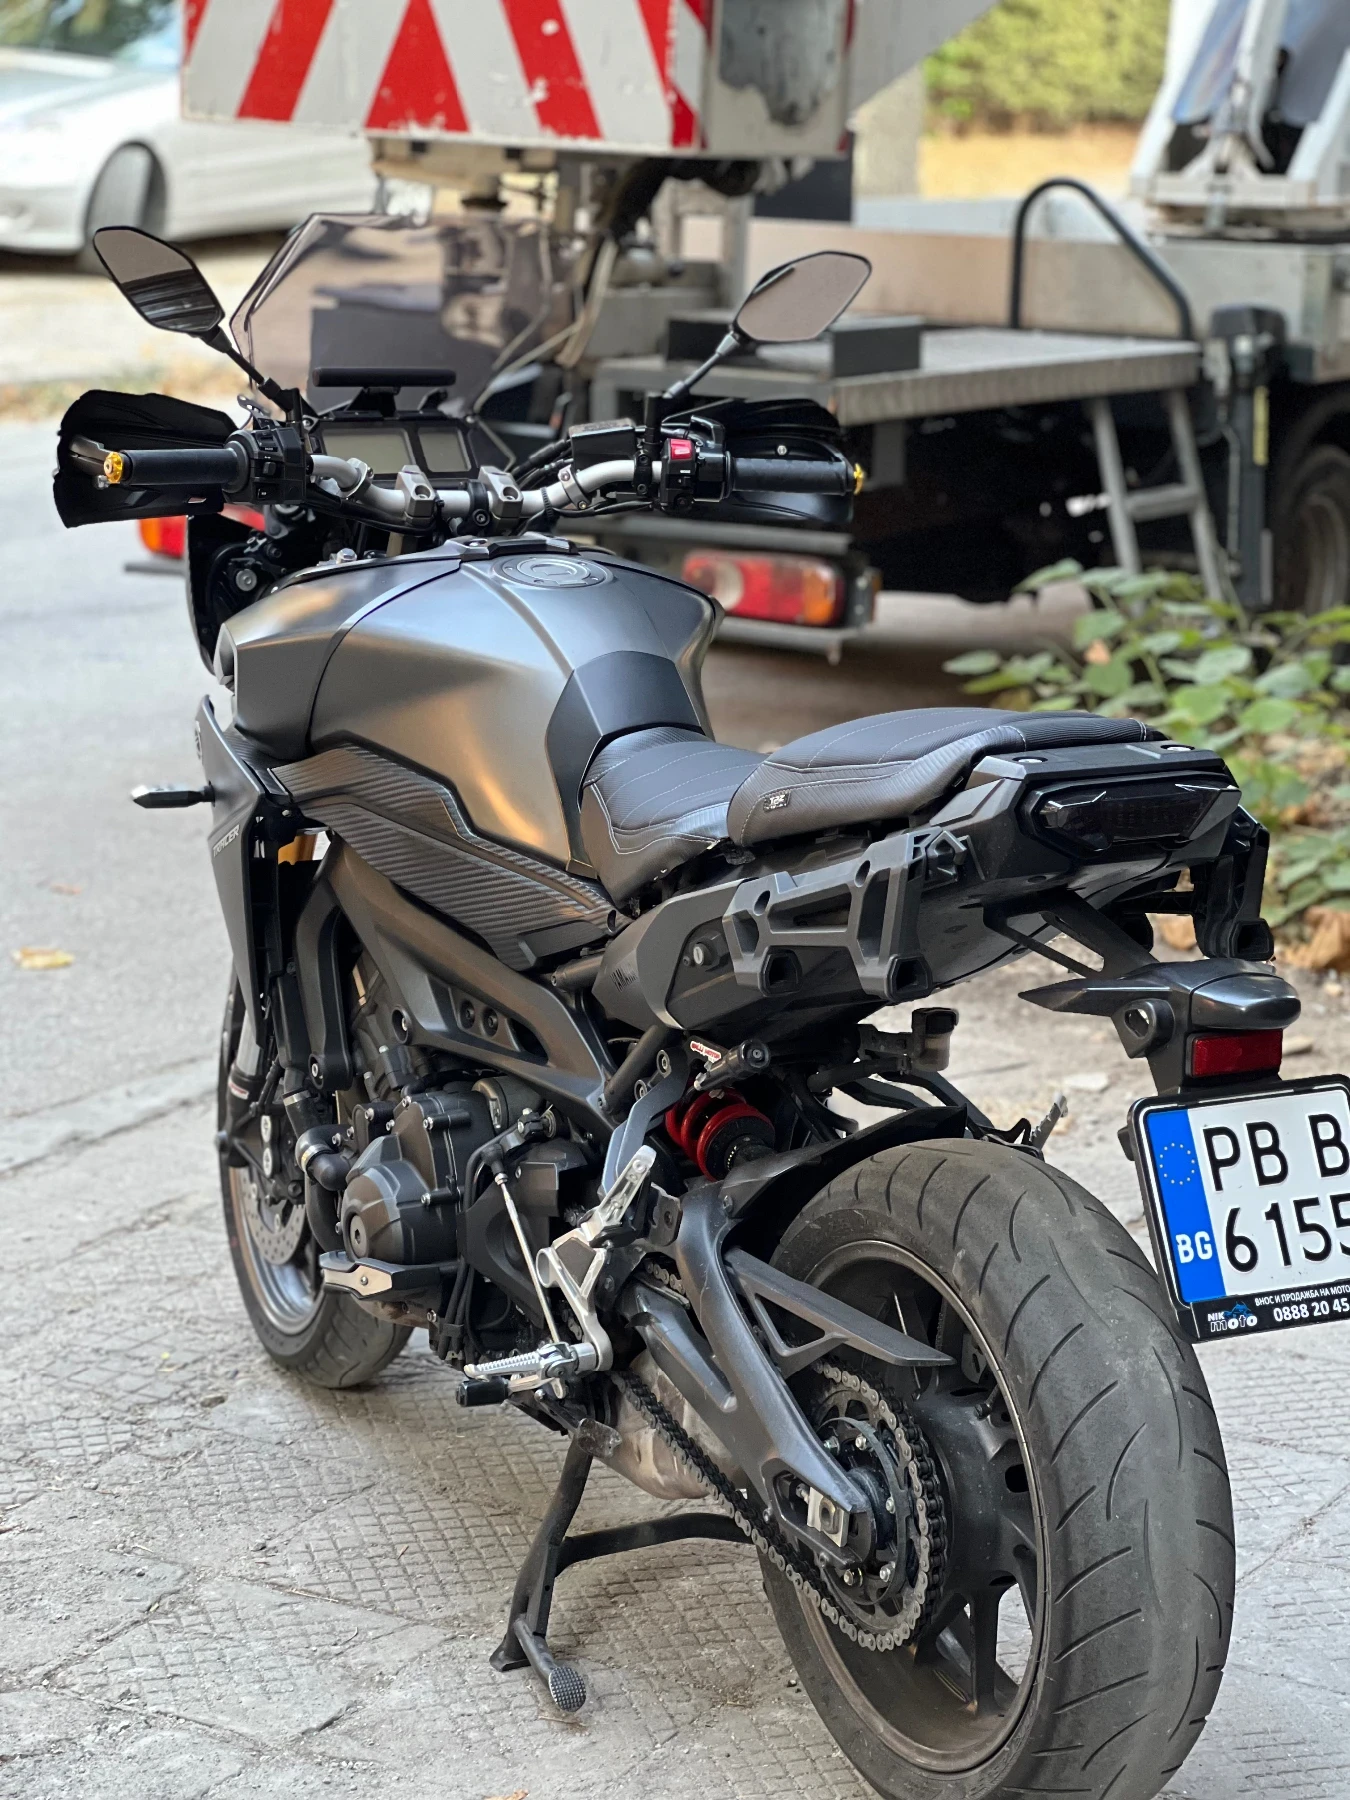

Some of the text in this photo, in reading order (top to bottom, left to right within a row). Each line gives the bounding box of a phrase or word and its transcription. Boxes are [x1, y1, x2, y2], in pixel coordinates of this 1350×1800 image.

[1202, 1112, 1350, 1192] PB B
[1175, 1230, 1213, 1264] BG
[1254, 1294, 1275, 1307] ВНОС
[1281, 1289, 1319, 1303] ПРОДАЖБА
[1320, 1288, 1330, 1297] НА
[1207, 1311, 1225, 1322] NIK
[1273, 1297, 1350, 1322] 0888 20 45
[1210, 1314, 1258, 1333] moto
